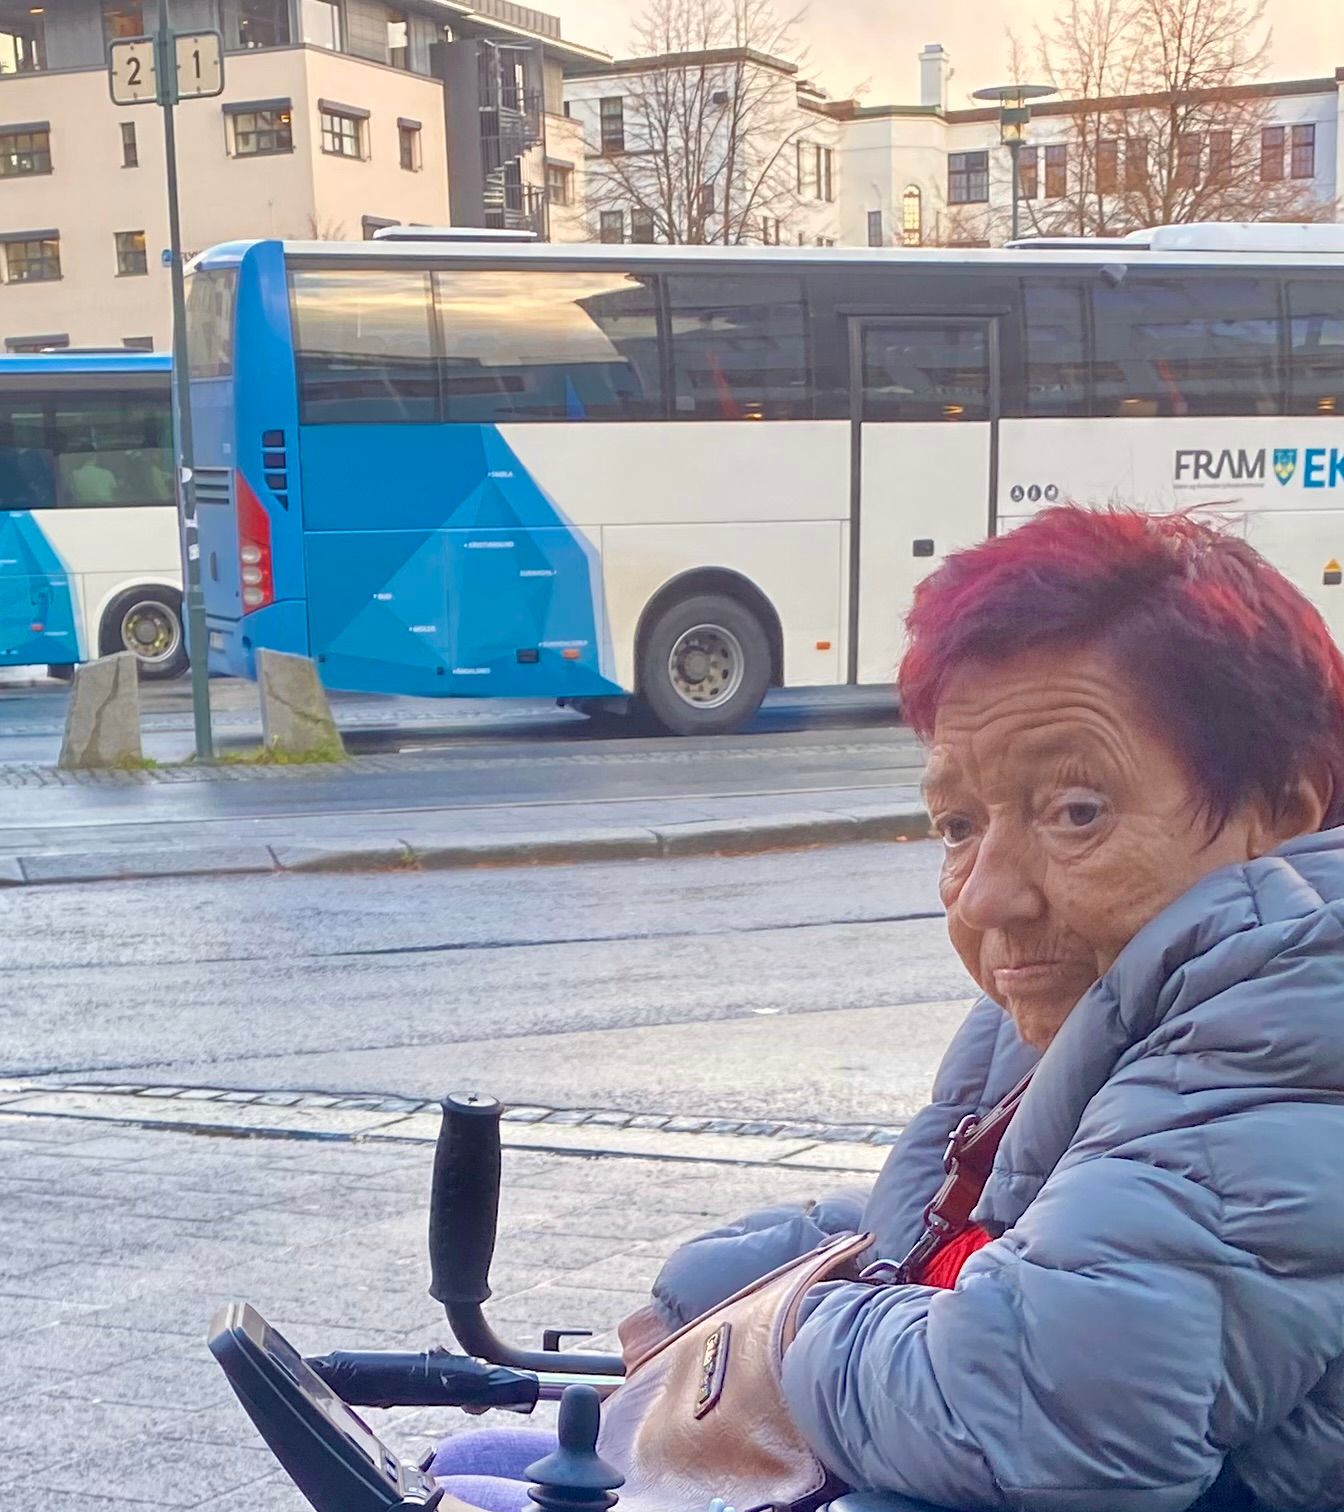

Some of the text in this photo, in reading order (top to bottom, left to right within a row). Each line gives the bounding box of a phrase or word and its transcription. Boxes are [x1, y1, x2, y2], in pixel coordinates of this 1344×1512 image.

[126, 56, 142, 86] 2
[192, 49, 201, 79] 1
[1173, 449, 1266, 479] FRAM
